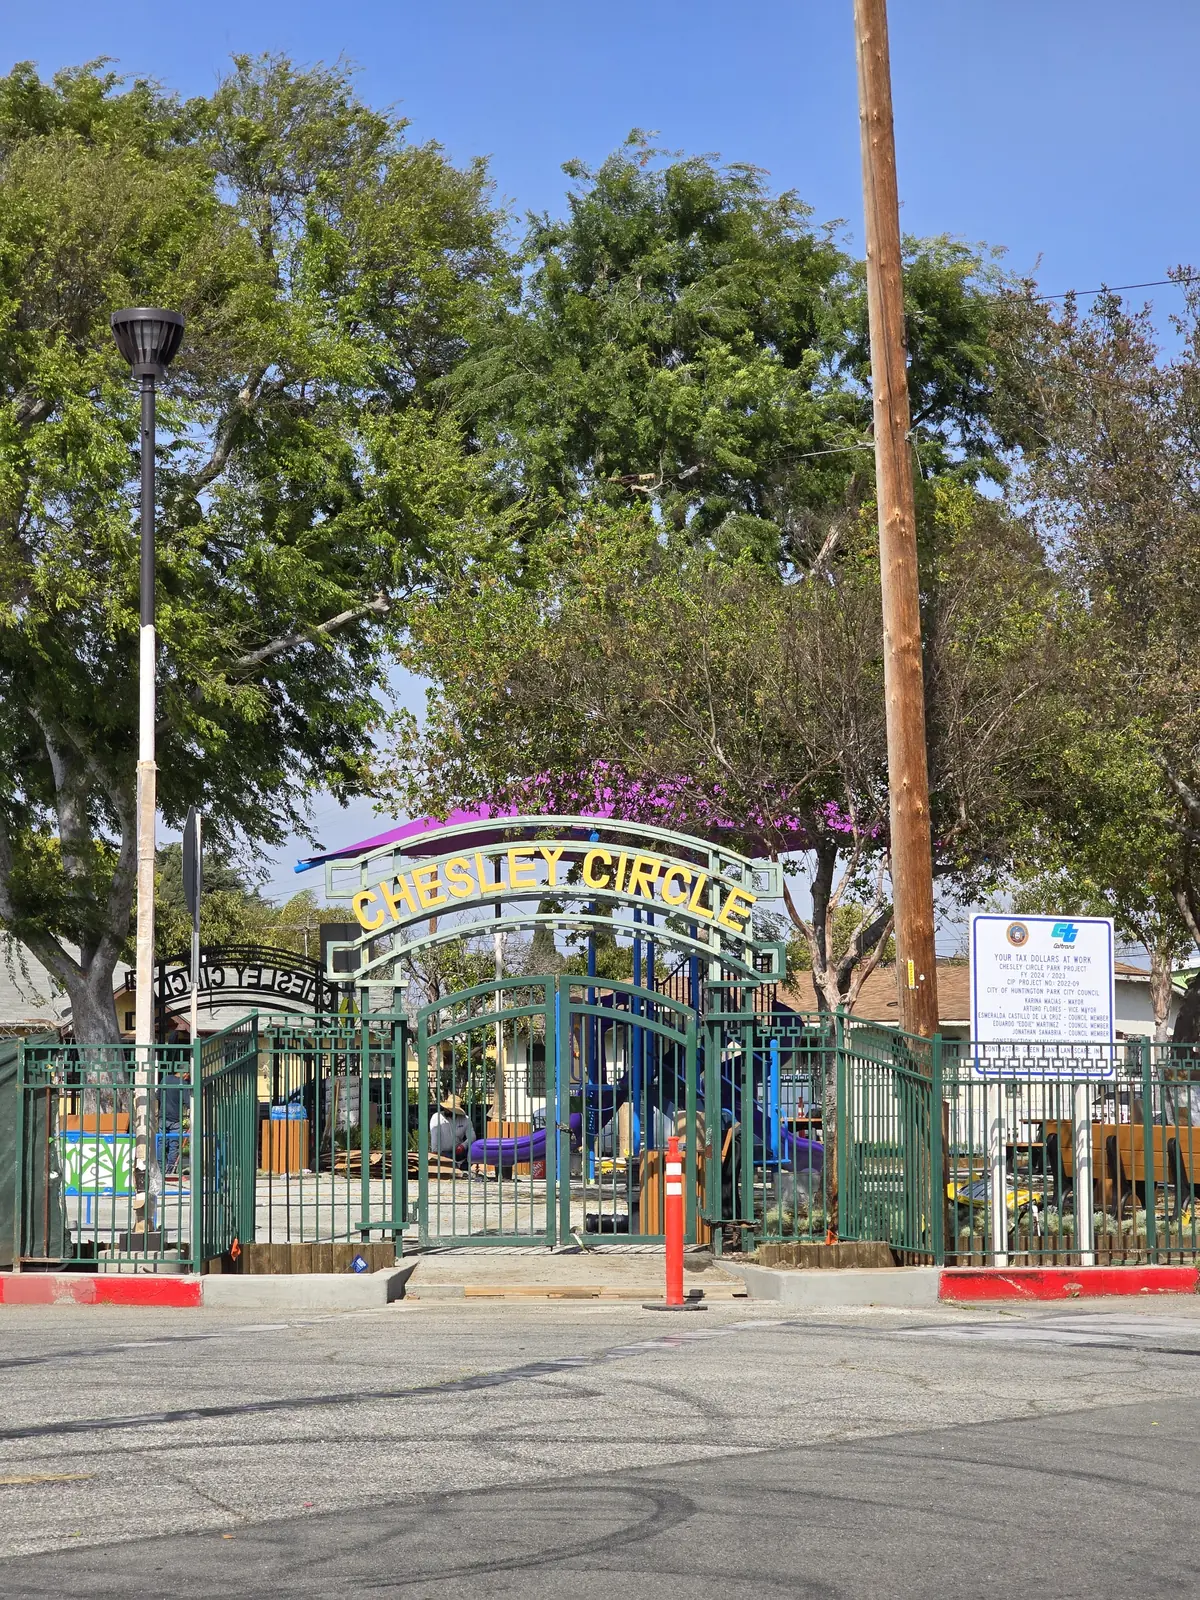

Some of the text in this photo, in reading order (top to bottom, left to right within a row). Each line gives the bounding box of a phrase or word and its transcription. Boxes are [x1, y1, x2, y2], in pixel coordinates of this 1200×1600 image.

[352, 847, 757, 932] CHESLEY CIRCLE
[994, 953, 1092, 964] YOUR TAX DOLLARS AT WORK
[1008, 1012, 1030, 1020] CASTILLO
